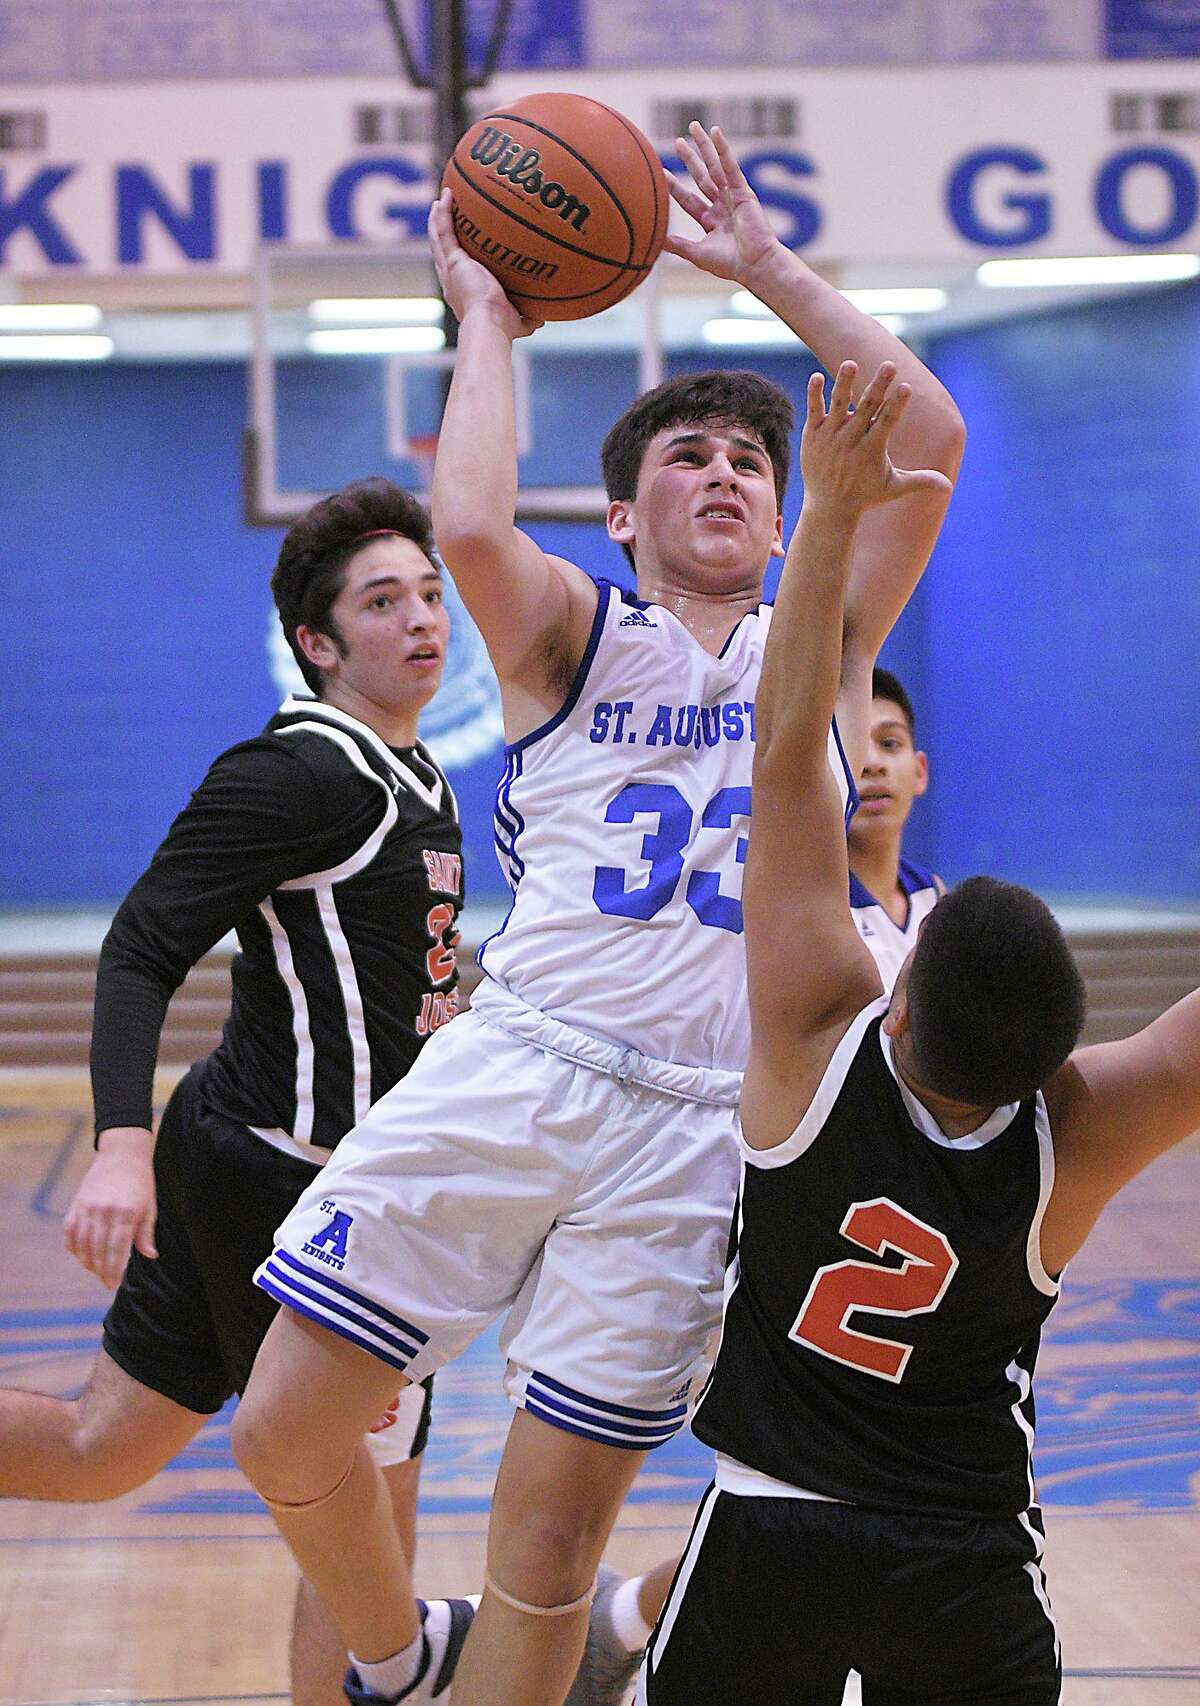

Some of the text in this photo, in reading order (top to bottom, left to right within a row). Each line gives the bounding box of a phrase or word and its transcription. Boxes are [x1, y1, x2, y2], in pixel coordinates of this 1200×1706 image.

[0, 143, 1200, 266] KNIGS GO
[470, 126, 592, 233] Wilson
[589, 701, 637, 744] ST.
[319, 1200, 336, 1215] ST.
[300, 1241, 346, 1271] KNIGHTS
[310, 1209, 354, 1260] A
[787, 1196, 960, 1385] 2
